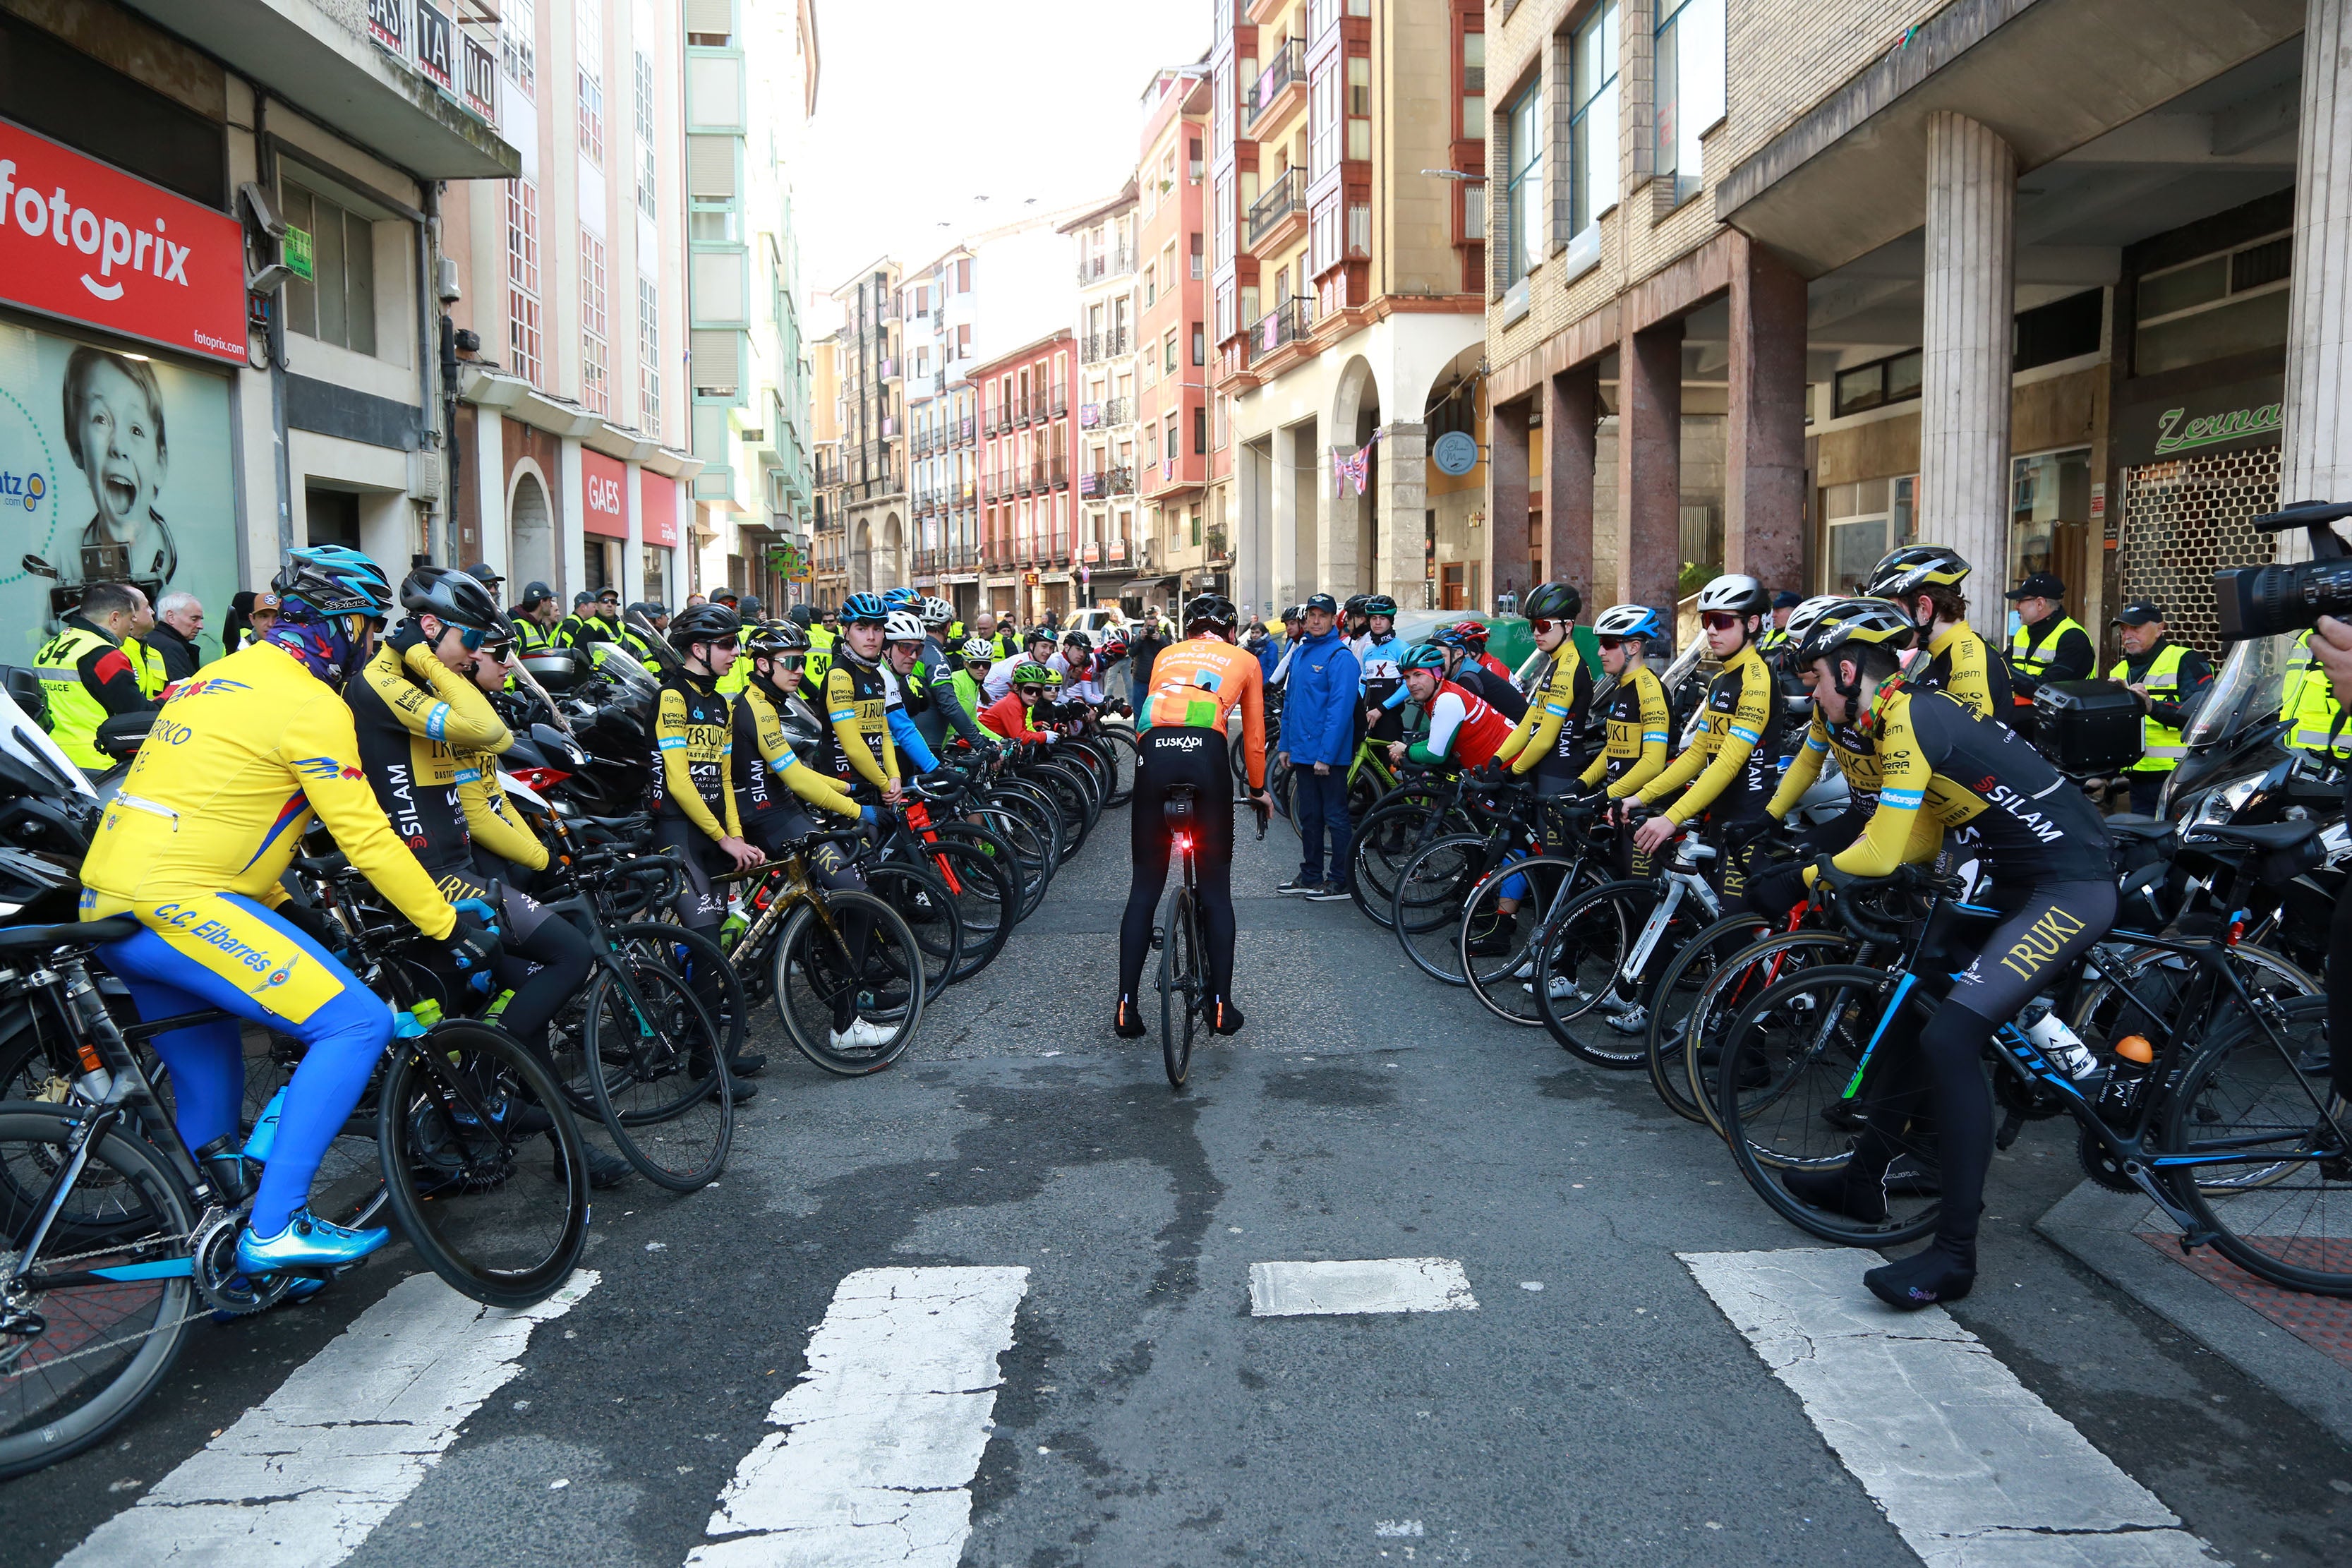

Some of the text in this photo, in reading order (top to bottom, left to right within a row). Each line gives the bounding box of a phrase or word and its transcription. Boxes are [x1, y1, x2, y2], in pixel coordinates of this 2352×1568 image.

[419, 8, 447, 73] TA
[466, 40, 492, 105] ÑO
[0, 159, 191, 287] fotoprix
[193, 330, 245, 356] fotoprix.com
[2156, 403, 2284, 452] Zerna
[589, 474, 620, 516] GAES
[38, 634, 83, 665] 34
[1744, 689, 1766, 698] agem
[1951, 670, 1981, 682] agem
[387, 764, 423, 836] SILAM
[751, 759, 769, 803] SILAM
[1986, 785, 2065, 843] SILAM
[190, 919, 272, 972] Eibarrés
[2000, 905, 2087, 982] IRUKI
[1818, 1003, 1845, 1051] ORBEA
[1584, 1045, 1629, 1061] BONTRAGER
